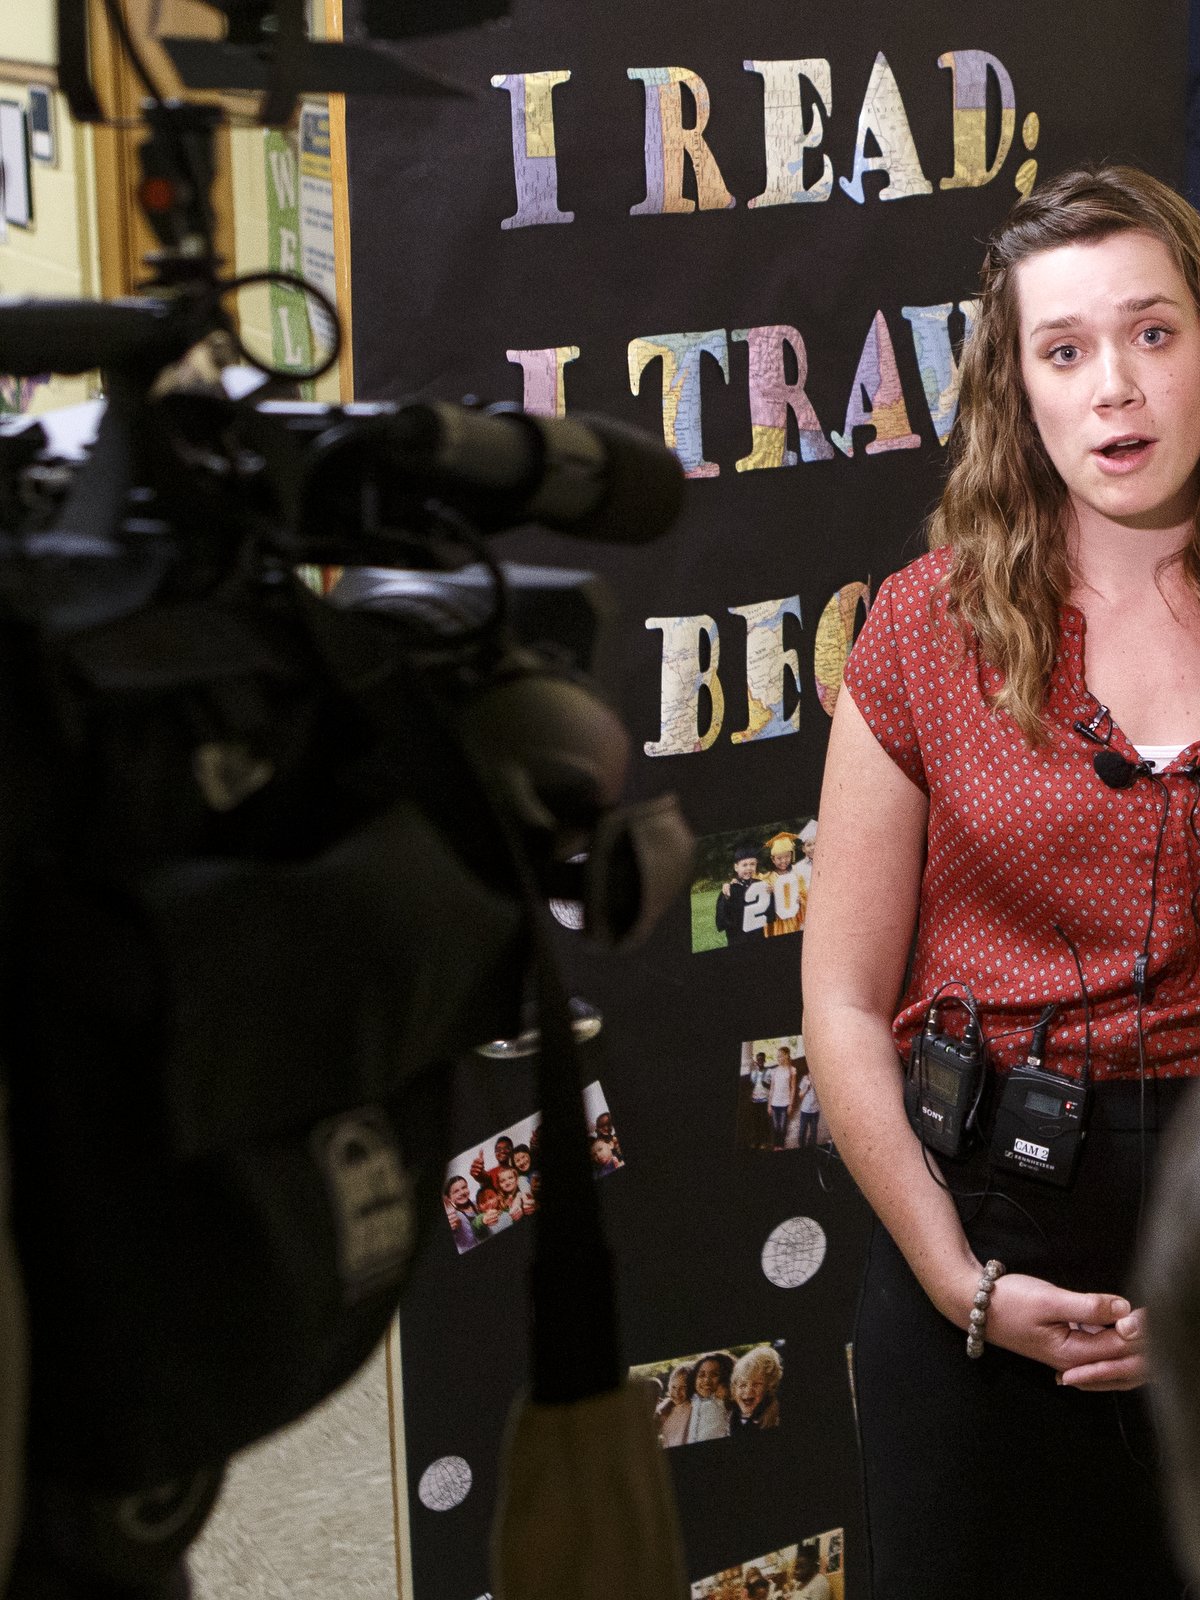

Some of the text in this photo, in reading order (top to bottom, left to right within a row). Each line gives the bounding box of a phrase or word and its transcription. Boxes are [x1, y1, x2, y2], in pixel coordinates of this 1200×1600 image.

[491, 70, 575, 230] I
[922, 1106, 944, 1121] SONY
[1015, 1140, 1049, 1159] CAM 2
